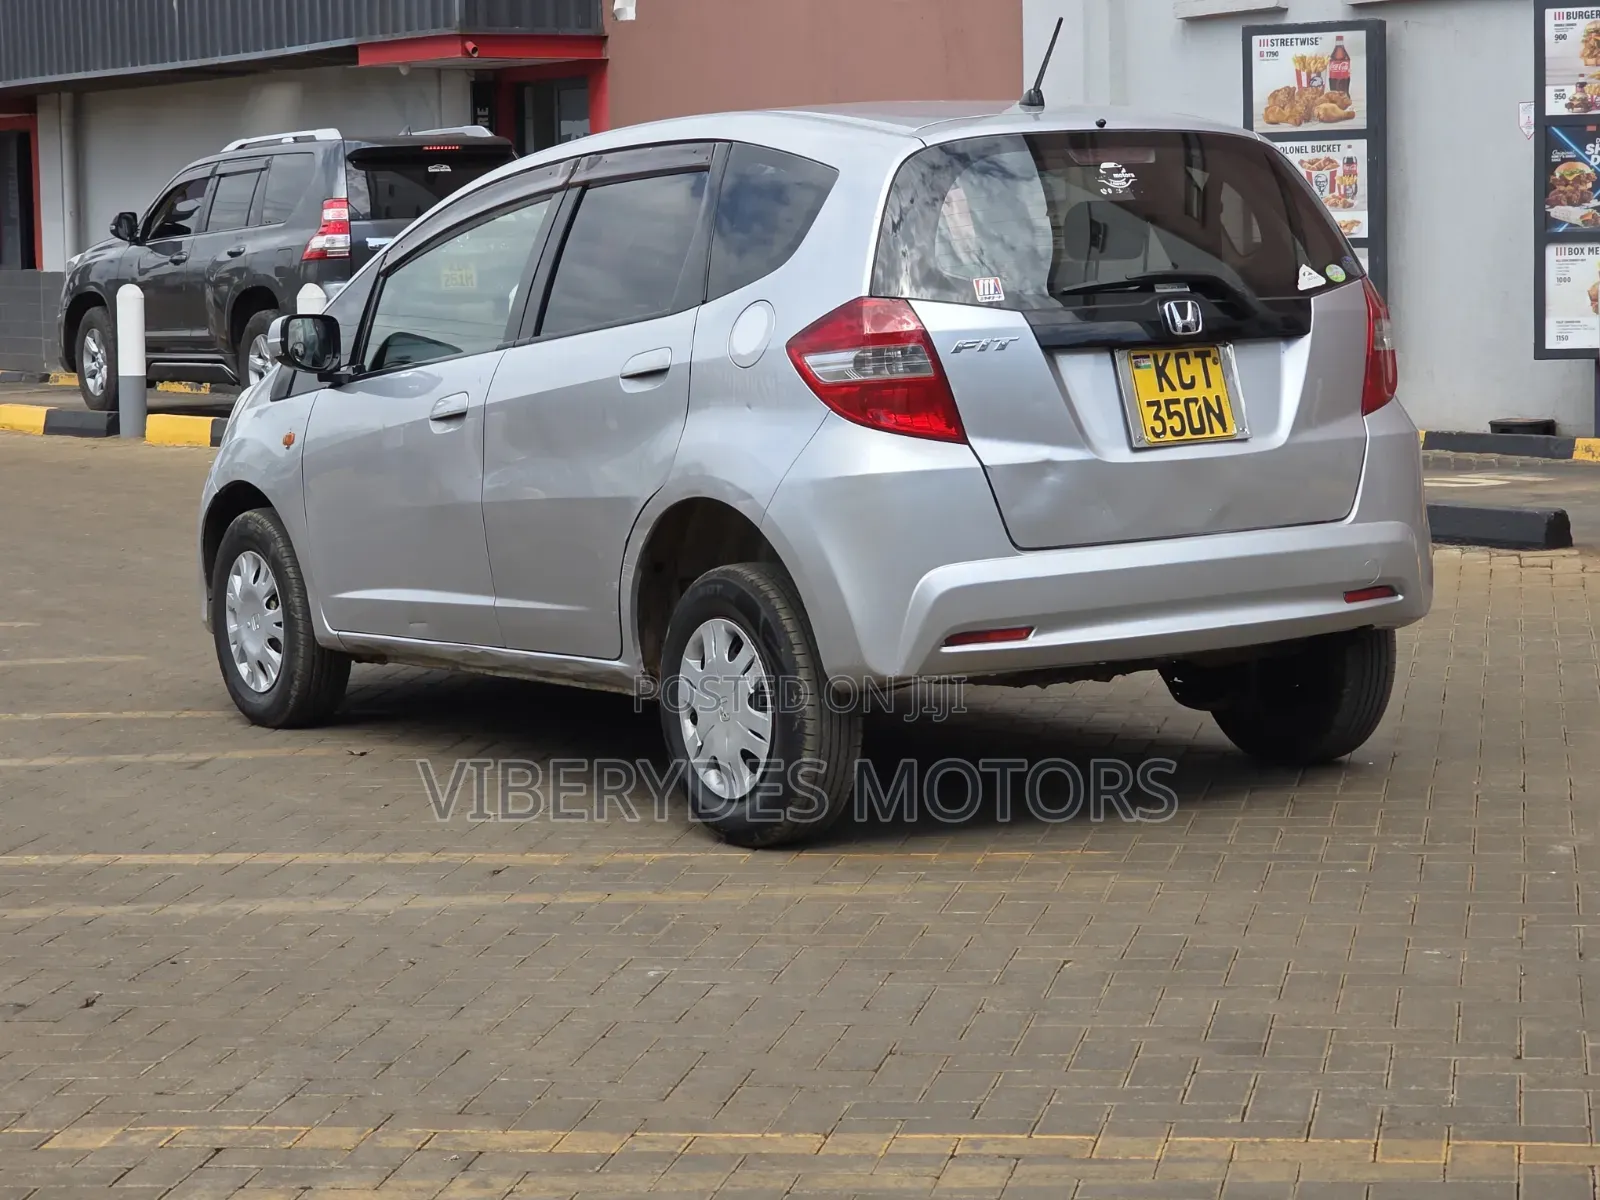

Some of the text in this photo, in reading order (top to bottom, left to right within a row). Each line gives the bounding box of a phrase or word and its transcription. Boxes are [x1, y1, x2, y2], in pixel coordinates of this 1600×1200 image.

[1270, 37, 1320, 47] STREETWISE
[1311, 144, 1341, 153] BUCKET
[1568, 247, 1585, 256] BOX
[951, 336, 1020, 354] FIT
[1153, 350, 1212, 392] KCT
[1146, 395, 1227, 439] 350N
